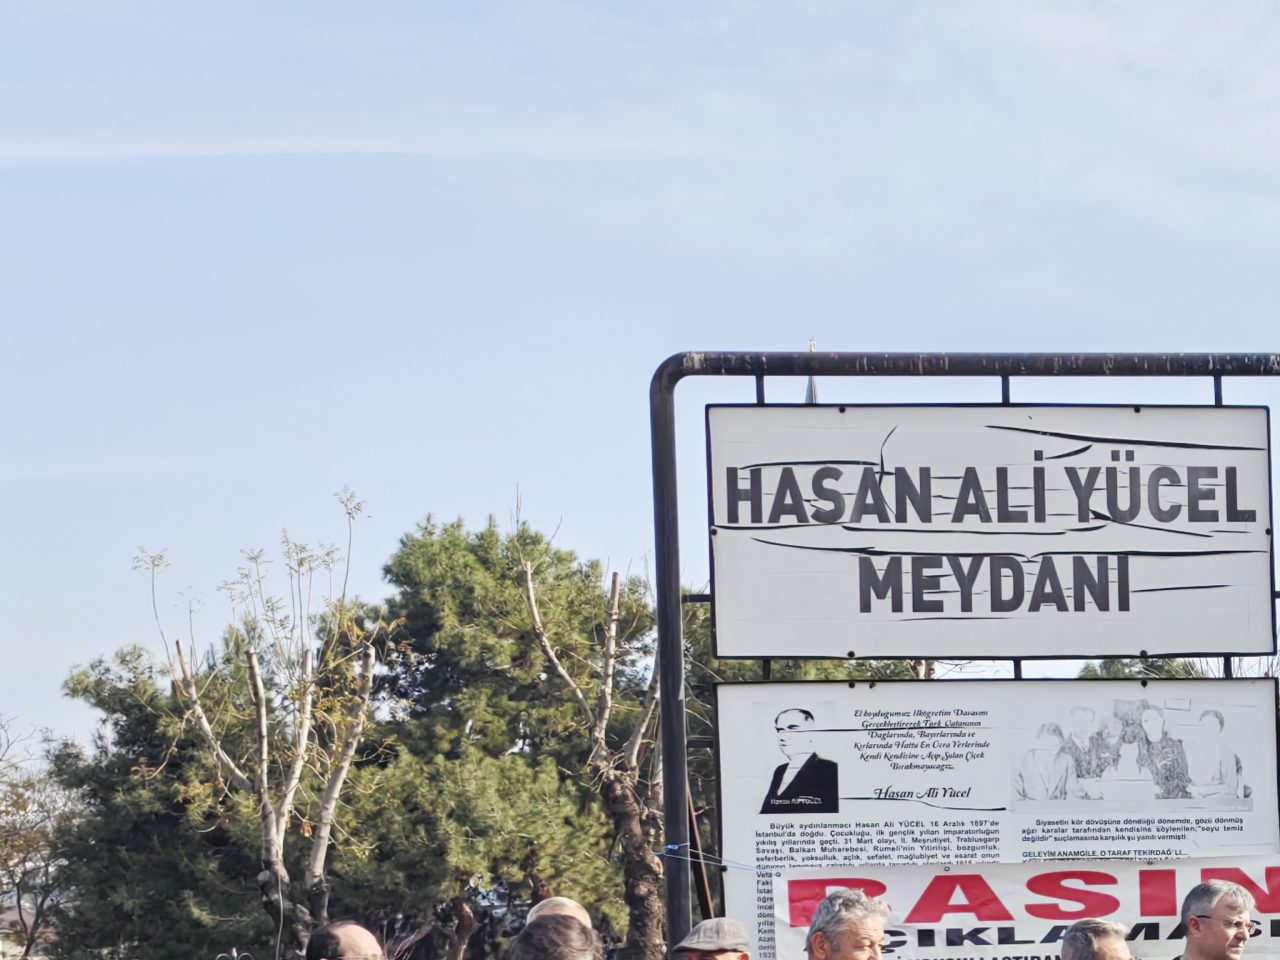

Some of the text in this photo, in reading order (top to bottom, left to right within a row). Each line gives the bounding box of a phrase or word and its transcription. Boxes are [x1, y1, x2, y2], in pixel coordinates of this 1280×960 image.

[726, 450, 1257, 524] HASAN ALİ YÜCEL
[858, 555, 1131, 613] MEYDANI
[873, 785, 972, 799] Hasan Ali Yücel
[770, 823, 795, 831] Büyük
[888, 829, 915, 838] gençlik
[956, 836, 1000, 845] Trablusgarp
[1022, 850, 1057, 858] GELEYİM
[1107, 849, 1131, 857] TARAF
